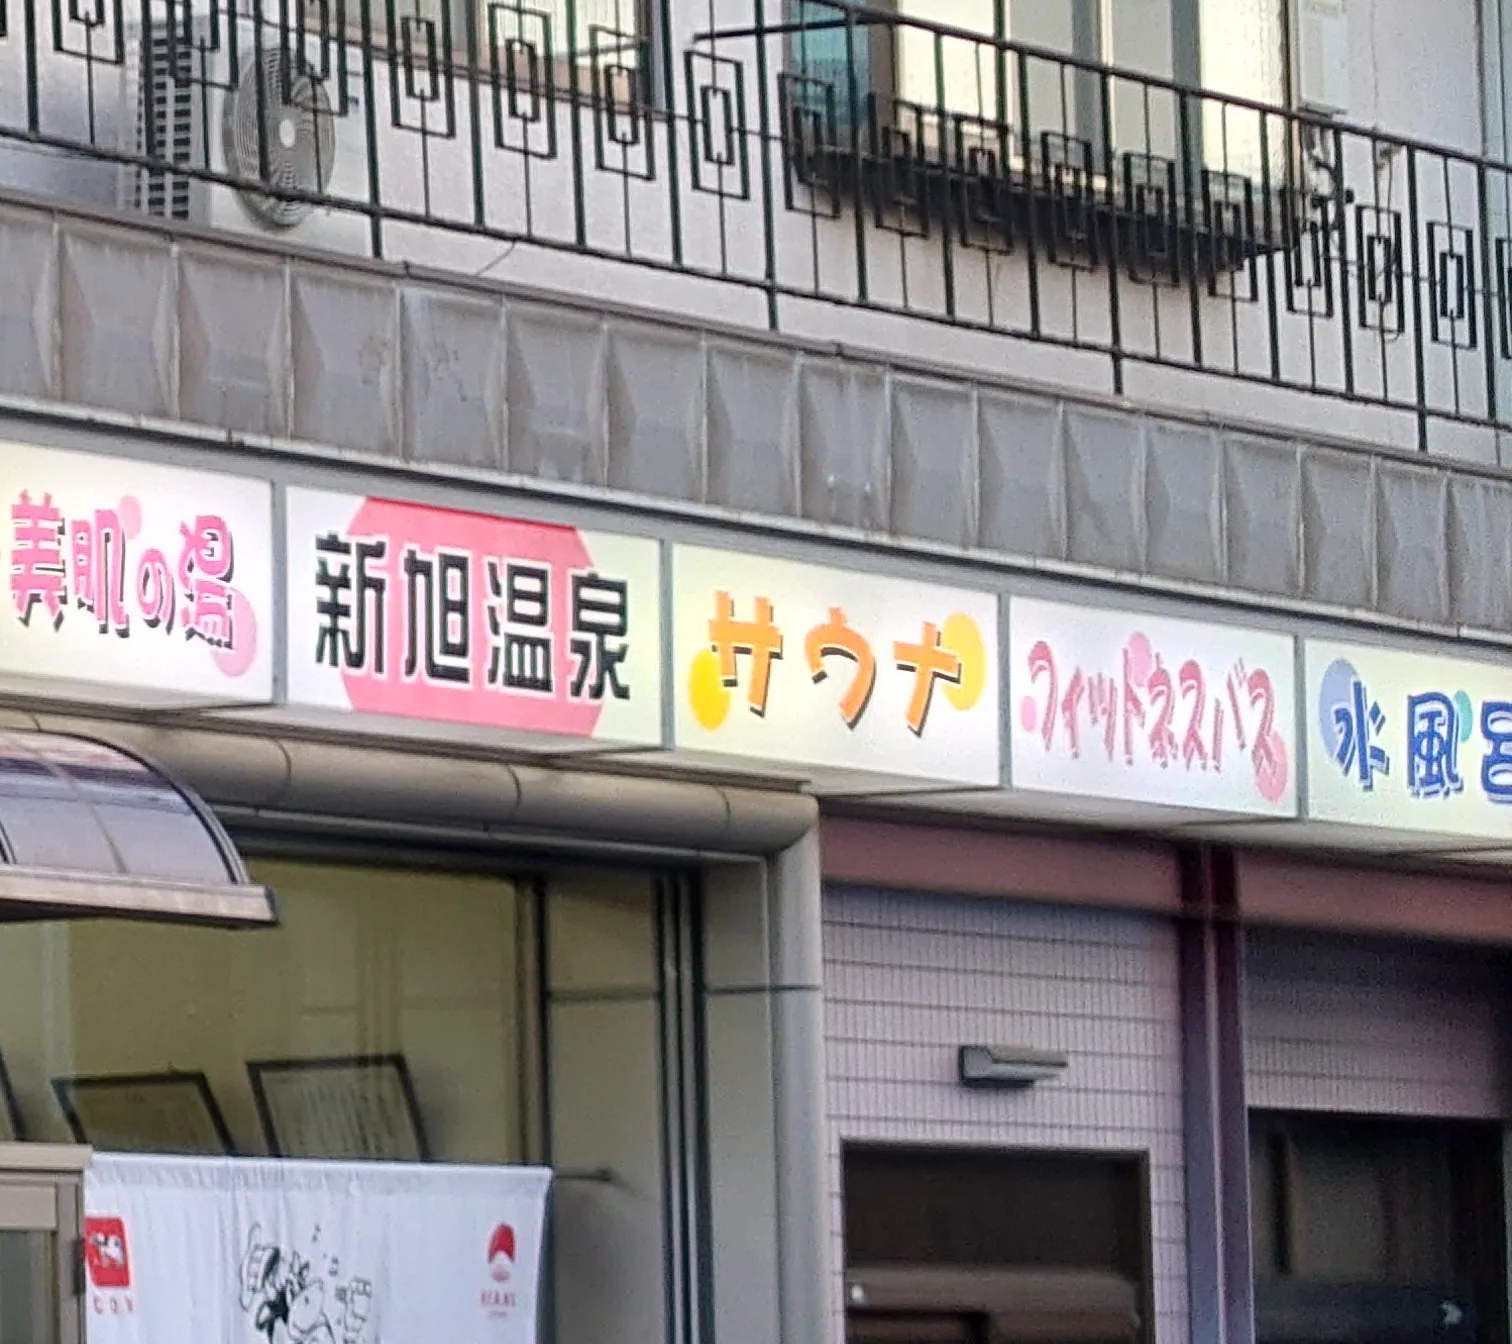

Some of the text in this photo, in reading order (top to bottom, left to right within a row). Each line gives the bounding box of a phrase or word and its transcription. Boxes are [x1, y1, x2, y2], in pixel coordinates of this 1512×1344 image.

[314, 531, 630, 701] 新旭温泉
[708, 590, 962, 738] サウナ
[1027, 640, 1276, 777] フィットネスバス
